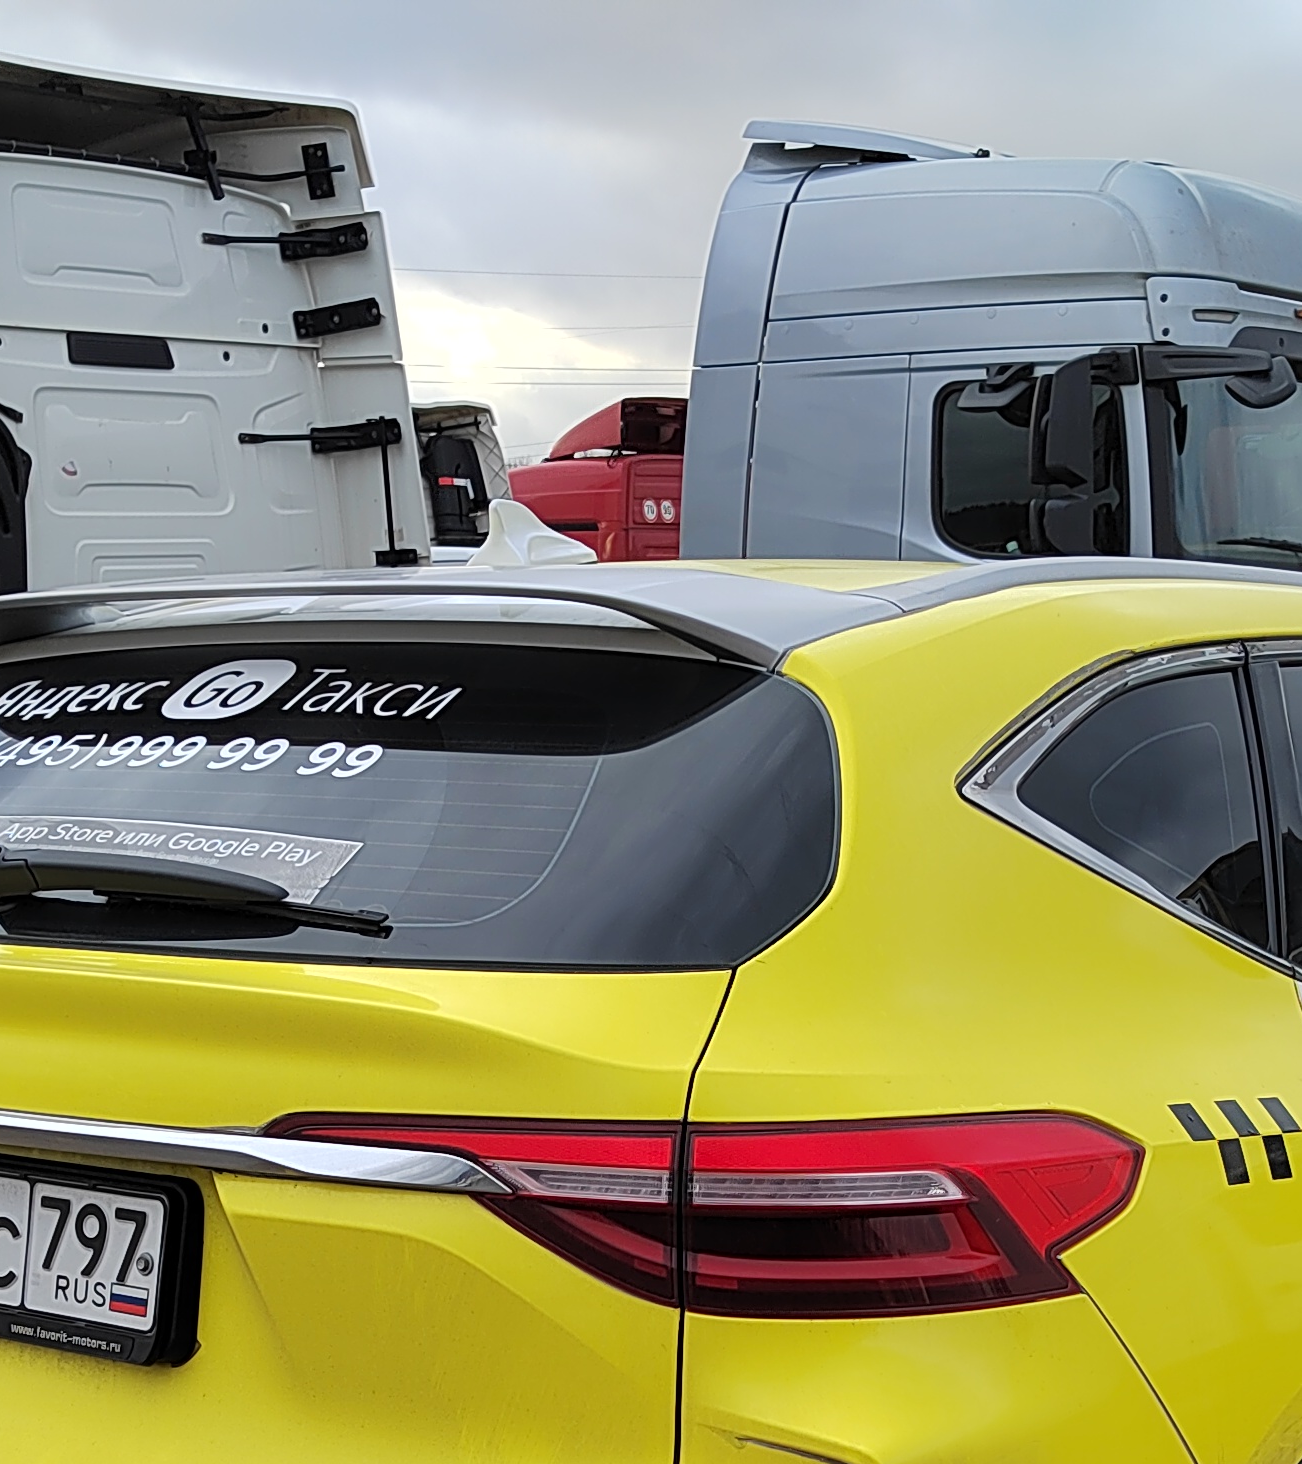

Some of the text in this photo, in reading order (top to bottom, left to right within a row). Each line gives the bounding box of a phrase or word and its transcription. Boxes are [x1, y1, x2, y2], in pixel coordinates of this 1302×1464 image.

[182, 669, 267, 709] Go
[282, 667, 463, 720] Такси
[206, 737, 290, 772] 99
[296, 741, 384, 778] 99
[49, 823, 114, 843] Store
[113, 831, 167, 847] или
[168, 832, 261, 858] Google
[260, 840, 322, 867] Play
[40, 1196, 148, 1283] 797
[55, 1275, 107, 1308] RUS
[10, 1323, 122, 1353] www.favorit-motors.ru
